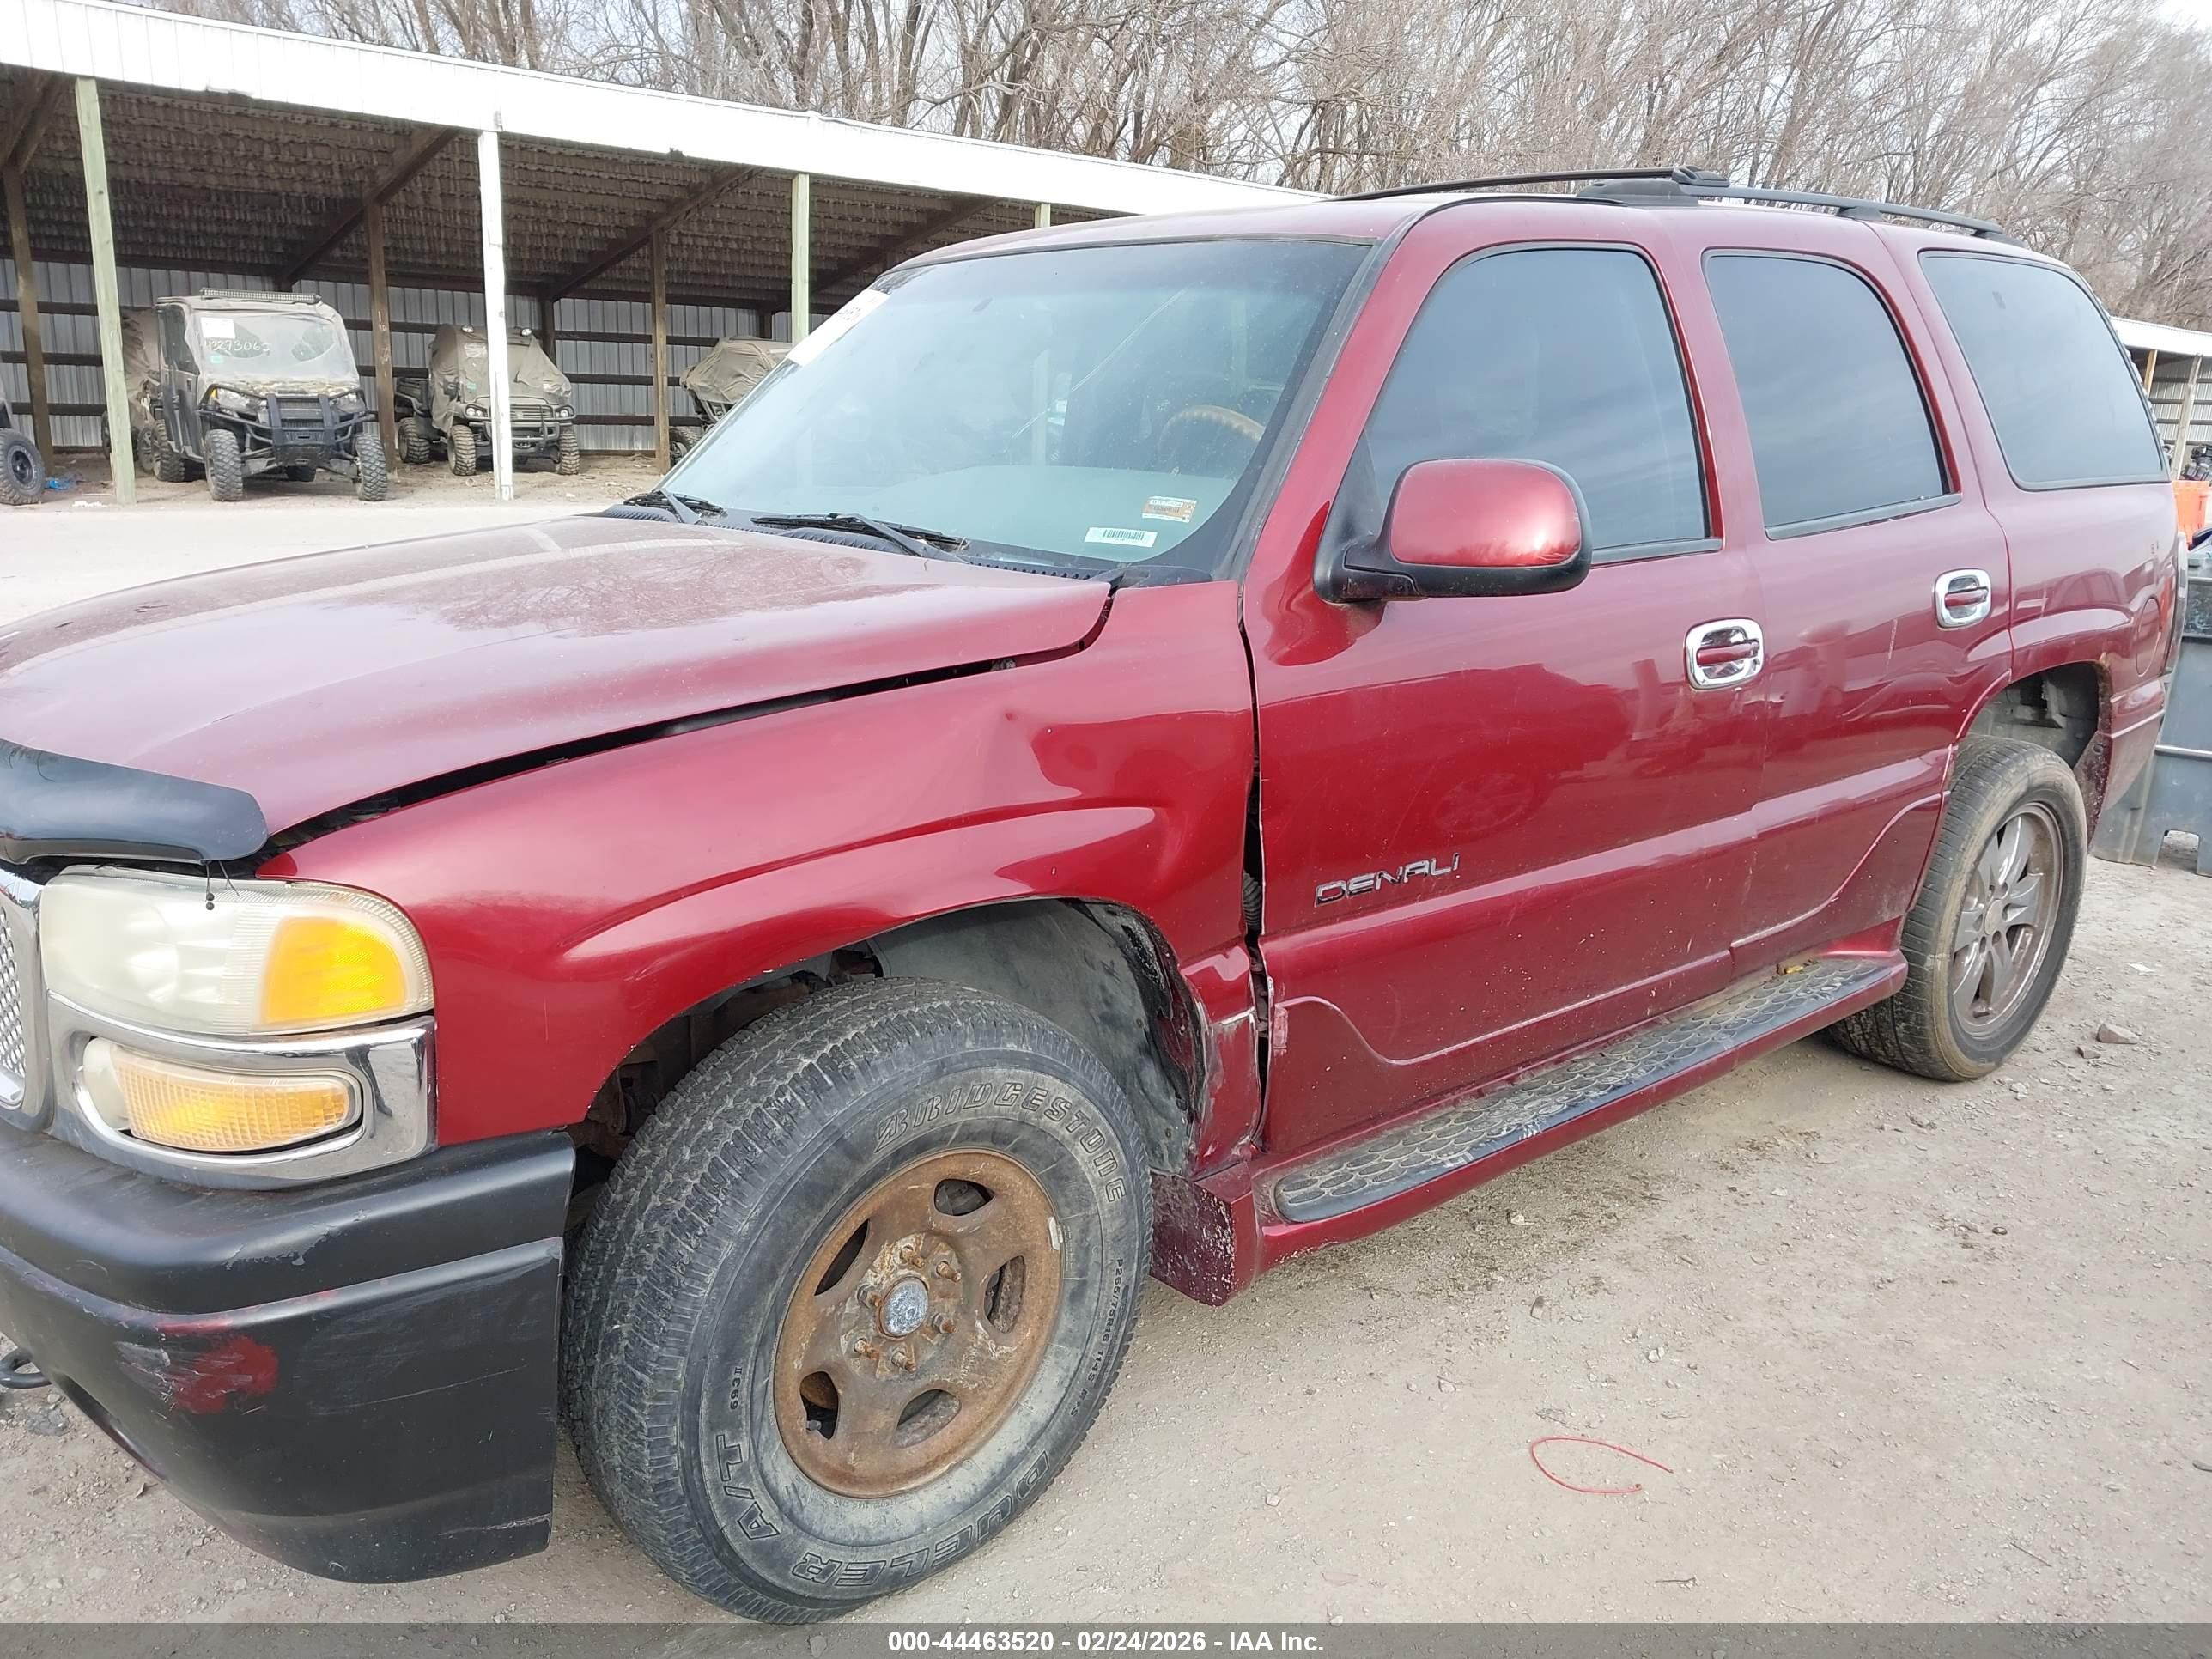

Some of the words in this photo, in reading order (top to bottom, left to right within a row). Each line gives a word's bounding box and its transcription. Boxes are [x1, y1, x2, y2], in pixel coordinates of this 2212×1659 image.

[1314, 853, 1460, 908] DENALI
[873, 1082, 1126, 1203] BRIDGESTONE
[1102, 1259, 1123, 1342] P265/75R16
[716, 1434, 780, 1540] A/T
[792, 1450, 1050, 1587] DUELER
